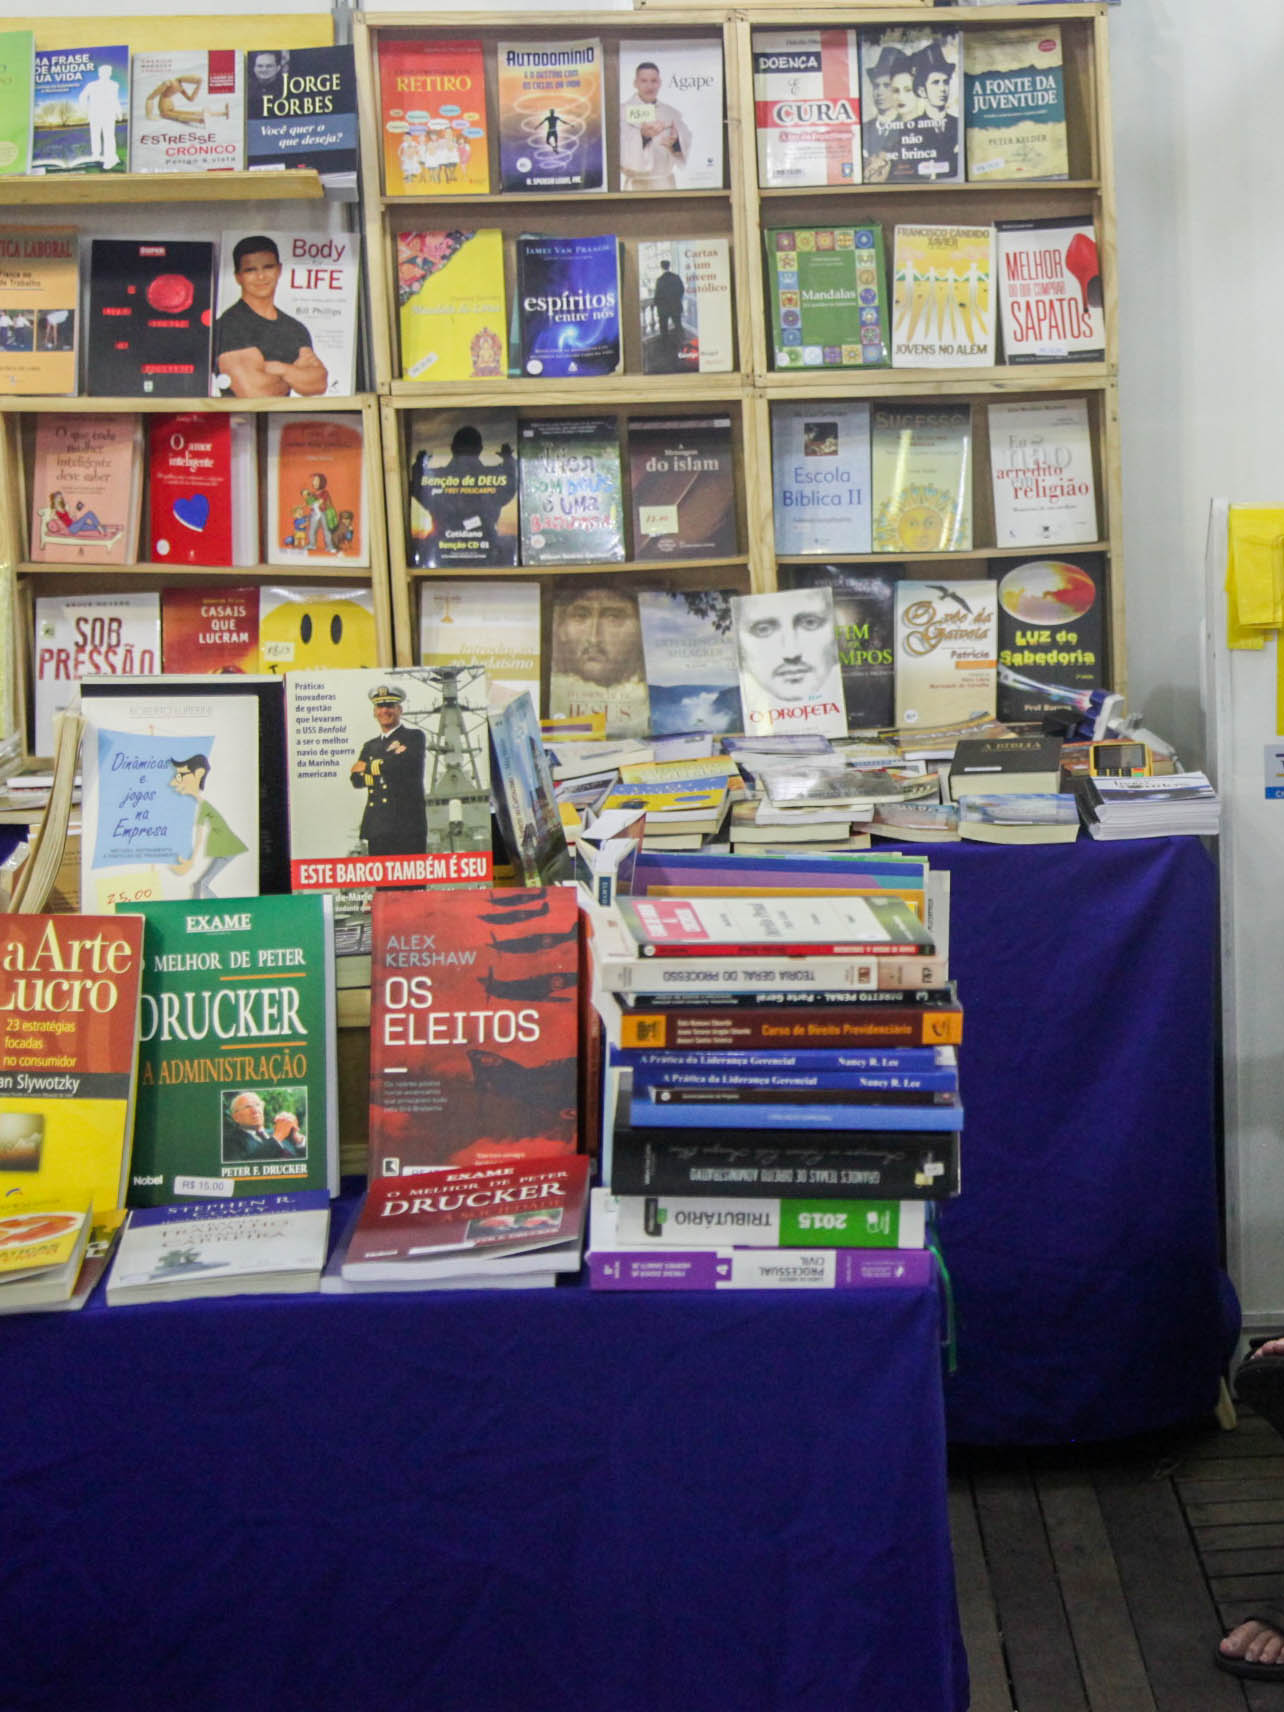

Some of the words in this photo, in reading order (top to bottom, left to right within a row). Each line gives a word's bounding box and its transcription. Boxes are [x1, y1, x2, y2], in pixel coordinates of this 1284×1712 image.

[52, 54, 90, 64] FRASE
[507, 47, 595, 67] AUTODOMÍNIO
[51, 63, 95, 73] MUDAR
[54, 72, 83, 81] VIDA
[396, 76, 472, 92] RETIRO
[669, 73, 714, 90] Ágape
[282, 73, 341, 99] JORGE
[973, 82, 984, 95] A
[986, 77, 1034, 94] FONTE
[1036, 75, 1056, 90] DA
[262, 95, 334, 118] FORBES
[971, 92, 1058, 114] JUVENTUDE
[775, 100, 855, 125] CURA
[261, 125, 287, 136] Você
[290, 126, 314, 137] quer
[876, 119, 902, 132] Com
[906, 121, 915, 131] o
[917, 117, 947, 130] amor
[140, 132, 216, 145] ESTRESSE
[279, 138, 301, 148] que
[302, 133, 343, 146] deseja?
[902, 133, 923, 145] não
[988, 135, 1013, 145] PETER
[165, 144, 236, 158] CRÔNICO
[886, 151, 899, 160] se
[902, 147, 937, 160] brinca
[897, 228, 949, 238] FRANCISCO
[23, 239, 73, 259] LABORAL
[292, 238, 345, 262] Body
[685, 249, 718, 258] Cartas
[1006, 249, 1064, 281] MELHOR
[290, 269, 344, 290] LIFE
[524, 288, 616, 316] espíritos
[802, 289, 856, 301] Mandalas
[555, 310, 589, 323] entre
[593, 309, 615, 320] nós
[1010, 297, 1093, 343] SAPATOS
[896, 344, 937, 355] JOVENS
[939, 344, 954, 355] NO
[170, 433, 185, 450] O
[188, 442, 212, 452] amor
[646, 458, 669, 472] do
[674, 456, 719, 472] islam
[996, 459, 1064, 480] acredito
[462, 475, 475, 485] de
[477, 474, 508, 486] DEUS
[794, 467, 851, 484] Escola
[782, 489, 842, 507] Bíblica
[847, 489, 862, 505] II
[1013, 477, 1090, 504] religião
[445, 529, 483, 538] Cotidiano
[200, 606, 246, 618] CASAIS
[74, 616, 122, 649] SOB
[211, 619, 236, 631] QUE
[199, 632, 249, 644] LUCRAM
[1015, 631, 1051, 646] LUZ
[1056, 630, 1078, 645] de
[38, 644, 155, 680] PRESSÃO
[1000, 650, 1095, 666] Sabedoria
[295, 682, 325, 690] Práticas
[295, 693, 336, 701] inovadoras
[306, 704, 332, 713] gestão
[296, 716, 308, 724] que
[311, 715, 342, 723] levaram
[303, 726, 316, 734] USS
[318, 726, 346, 734] Benfold
[323, 737, 348, 745] melhor
[297, 748, 317, 756] navio
[319, 748, 328, 756] de
[330, 748, 355, 758] guerra
[112, 752, 170, 771] Dinâmicas
[308, 759, 339, 767] Marinha
[298, 770, 337, 778] americana
[119, 790, 156, 808] jogos
[135, 810, 149, 820] na
[113, 818, 168, 843] Empresa
[300, 864, 334, 884] ESTE
[336, 861, 383, 882] BARCO
[385, 855, 446, 880] TAMBÉM
[450, 855, 458, 878] É
[461, 857, 487, 877] SEU
[186, 914, 251, 932] EXAME
[32, 920, 132, 974] Arte
[387, 935, 435, 950] ALEX
[154, 952, 222, 972] MELHOR
[229, 951, 250, 968] DE
[258, 948, 306, 966] PETER
[386, 951, 476, 967] KERSHAW
[663, 971, 719, 982] PROCESSO
[722, 971, 738, 981] DO
[742, 971, 776, 982] GERAL
[779, 970, 815, 982] TEORIA
[384, 976, 433, 1009] OS
[139, 986, 308, 1042] DRUCKER
[6, 1019, 19, 1032] 23
[22, 1018, 75, 1033] estratégias
[384, 1009, 540, 1046] ELEITOS
[761, 1025, 790, 1036] Curso
[808, 1024, 840, 1036] Direito
[5, 1036, 43, 1050] focadas
[3, 1057, 16, 1067] no
[19, 1054, 76, 1068] consumidor
[158, 1049, 307, 1085] ADMINISTRAÇÃO
[650, 1053, 684, 1065] Prática
[701, 1054, 748, 1067] Liderança
[751, 1055, 796, 1065] Gerencial
[838, 1057, 865, 1069] Nancy
[17, 1073, 80, 1094] Slywotzky
[673, 1073, 706, 1085] Prática
[722, 1075, 769, 1087] Liderança
[771, 1075, 818, 1086] Gerencial
[860, 1077, 886, 1089] Nancy
[221, 1166, 250, 1178] PETER
[262, 1163, 308, 1176] DRUCKER
[447, 1168, 515, 1182] EXAME
[689, 1168, 760, 1183] ADMINISTRATIVO
[762, 1169, 794, 1183] DIREITO
[810, 1170, 840, 1184] TEMAS
[841, 1170, 881, 1185] GRANDES
[133, 1174, 163, 1187] Nobel
[182, 1180, 196, 1192] R$
[410, 1182, 478, 1197] MELHOR
[490, 1178, 511, 1188] DE
[519, 1171, 568, 1183] PETER
[380, 1182, 567, 1217] DRUCKER
[675, 1211, 773, 1230] TRIBUTÁRIO
[797, 1212, 848, 1230] 2015
[801, 1257, 825, 1267] CIVIL
[759, 1266, 825, 1276] PROCESSUAL
